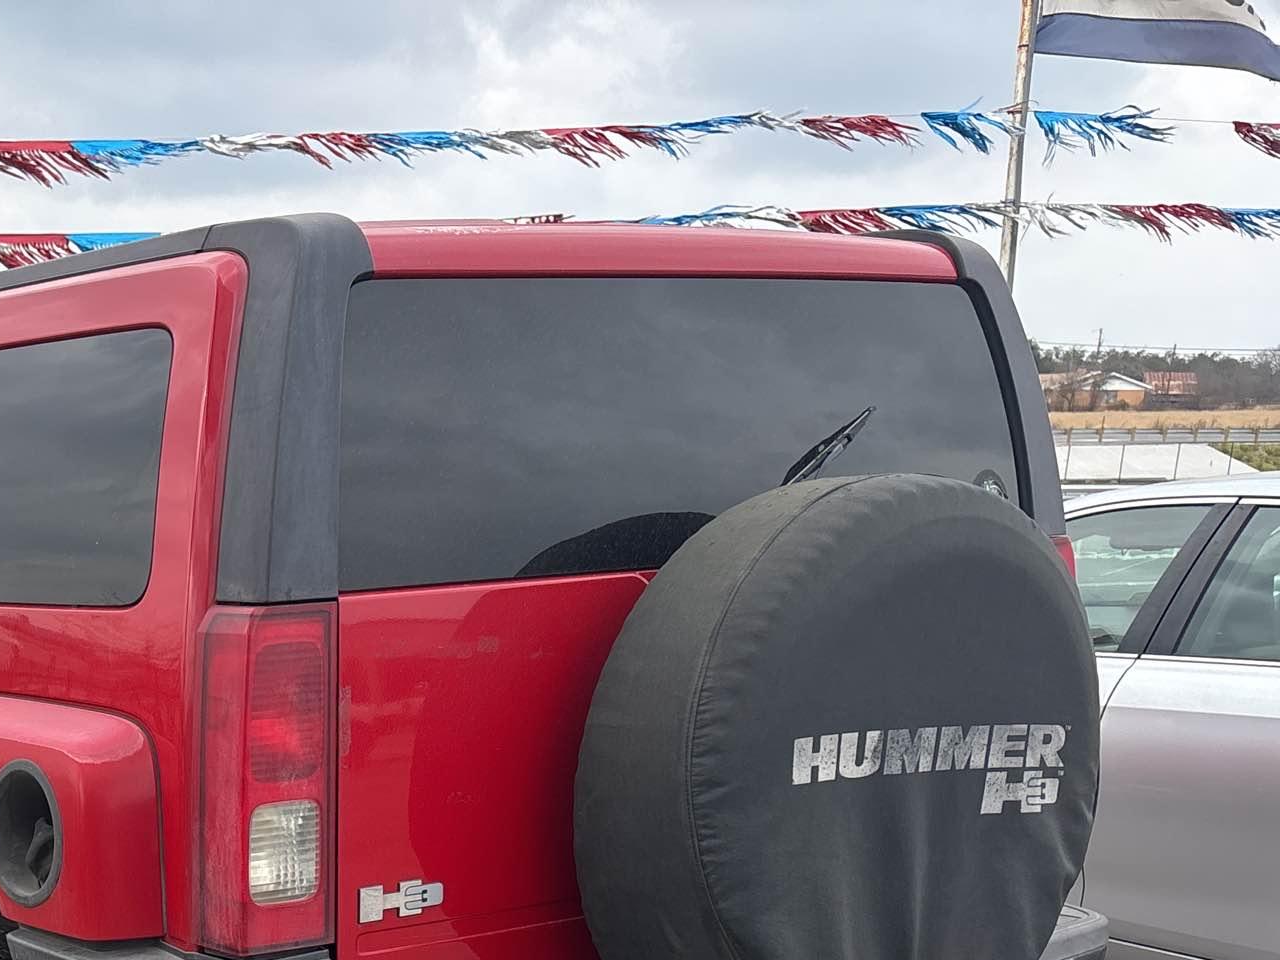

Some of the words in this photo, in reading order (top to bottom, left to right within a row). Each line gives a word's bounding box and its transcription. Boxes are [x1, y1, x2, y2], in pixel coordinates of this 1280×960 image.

[792, 724, 1066, 786] HUMMER
[980, 771, 1060, 815] H3
[358, 879, 444, 924] H3
